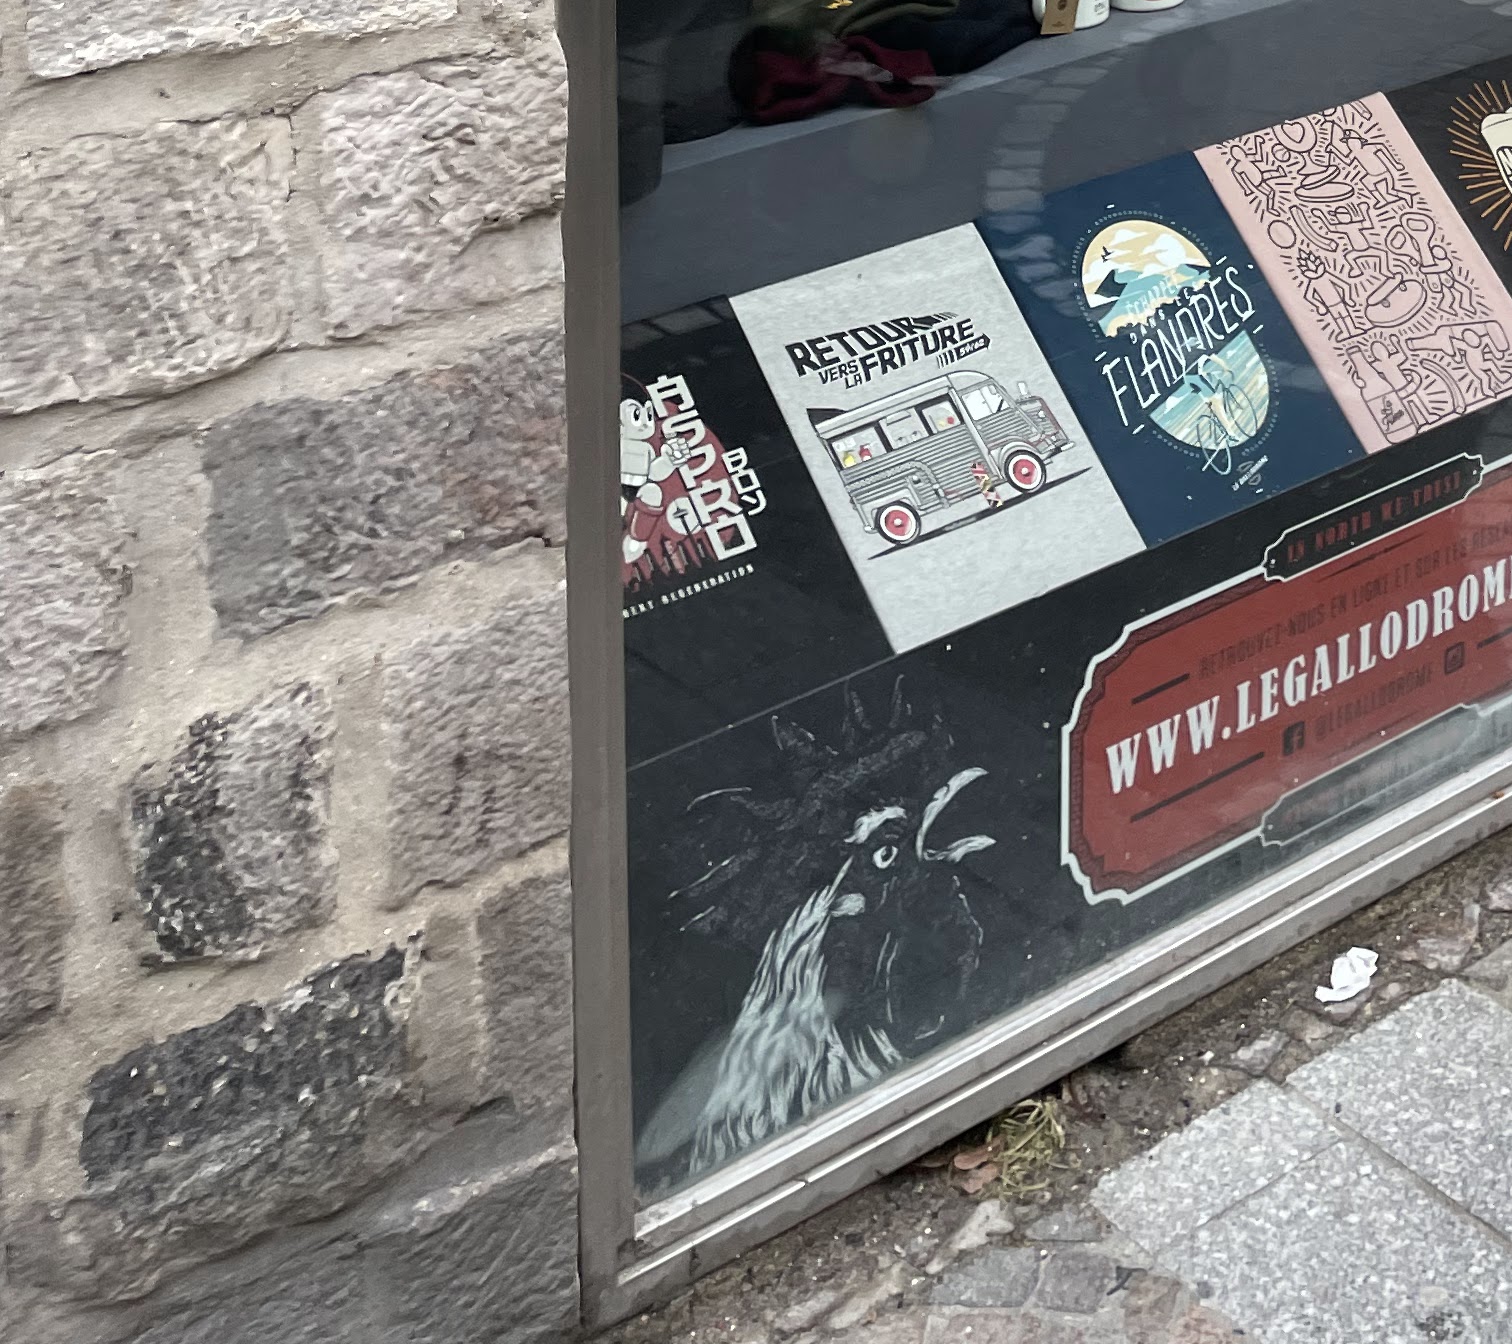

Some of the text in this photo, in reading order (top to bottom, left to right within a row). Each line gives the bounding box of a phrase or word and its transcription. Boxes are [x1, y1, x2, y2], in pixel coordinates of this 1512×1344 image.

[785, 314, 920, 378] RETOUR
[818, 359, 859, 385] VERS
[858, 318, 975, 383] FRITURE
[1102, 266, 1256, 427] FLANDRES
[844, 373, 863, 389] LA
